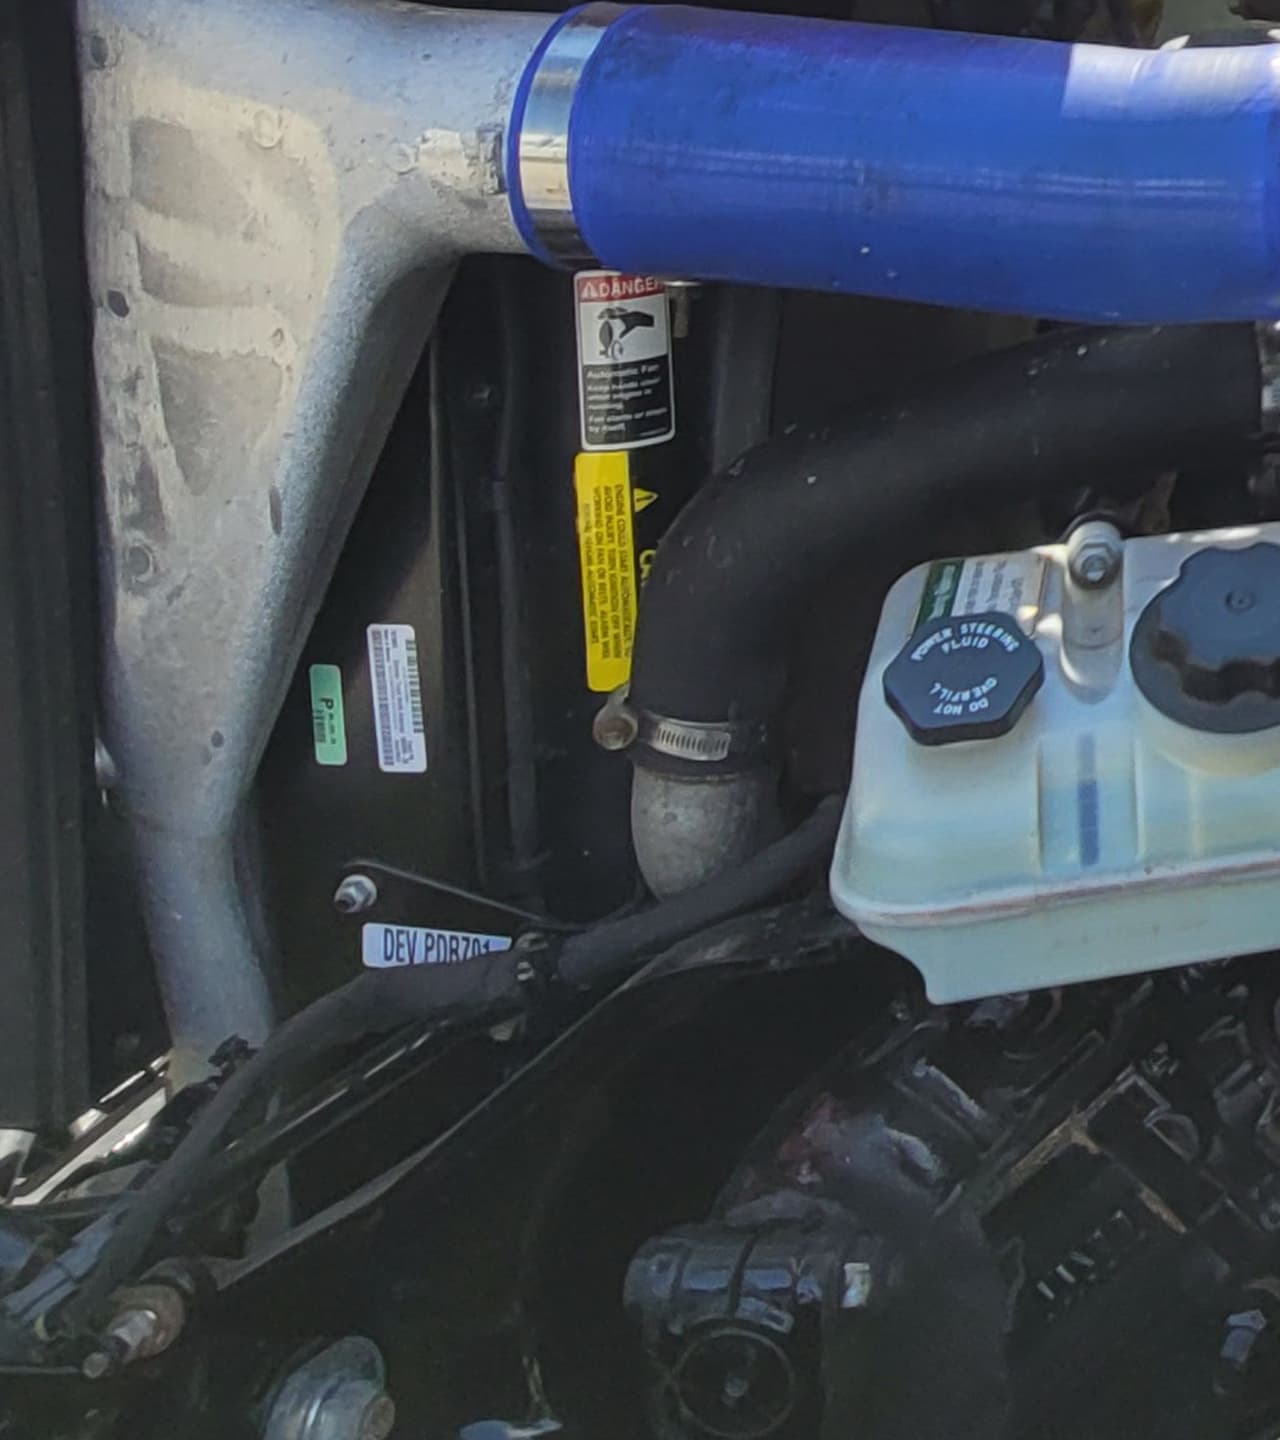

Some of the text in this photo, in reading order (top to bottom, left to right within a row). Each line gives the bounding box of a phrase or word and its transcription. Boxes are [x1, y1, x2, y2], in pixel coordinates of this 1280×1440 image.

[599, 276, 662, 297] DANGE
[910, 622, 1021, 662] POWER STEERING
[941, 635, 990, 654] FLUID
[929, 677, 998, 702] OVERFILL
[933, 698, 989, 715] DO NOT
[383, 927, 418, 964] DEV
